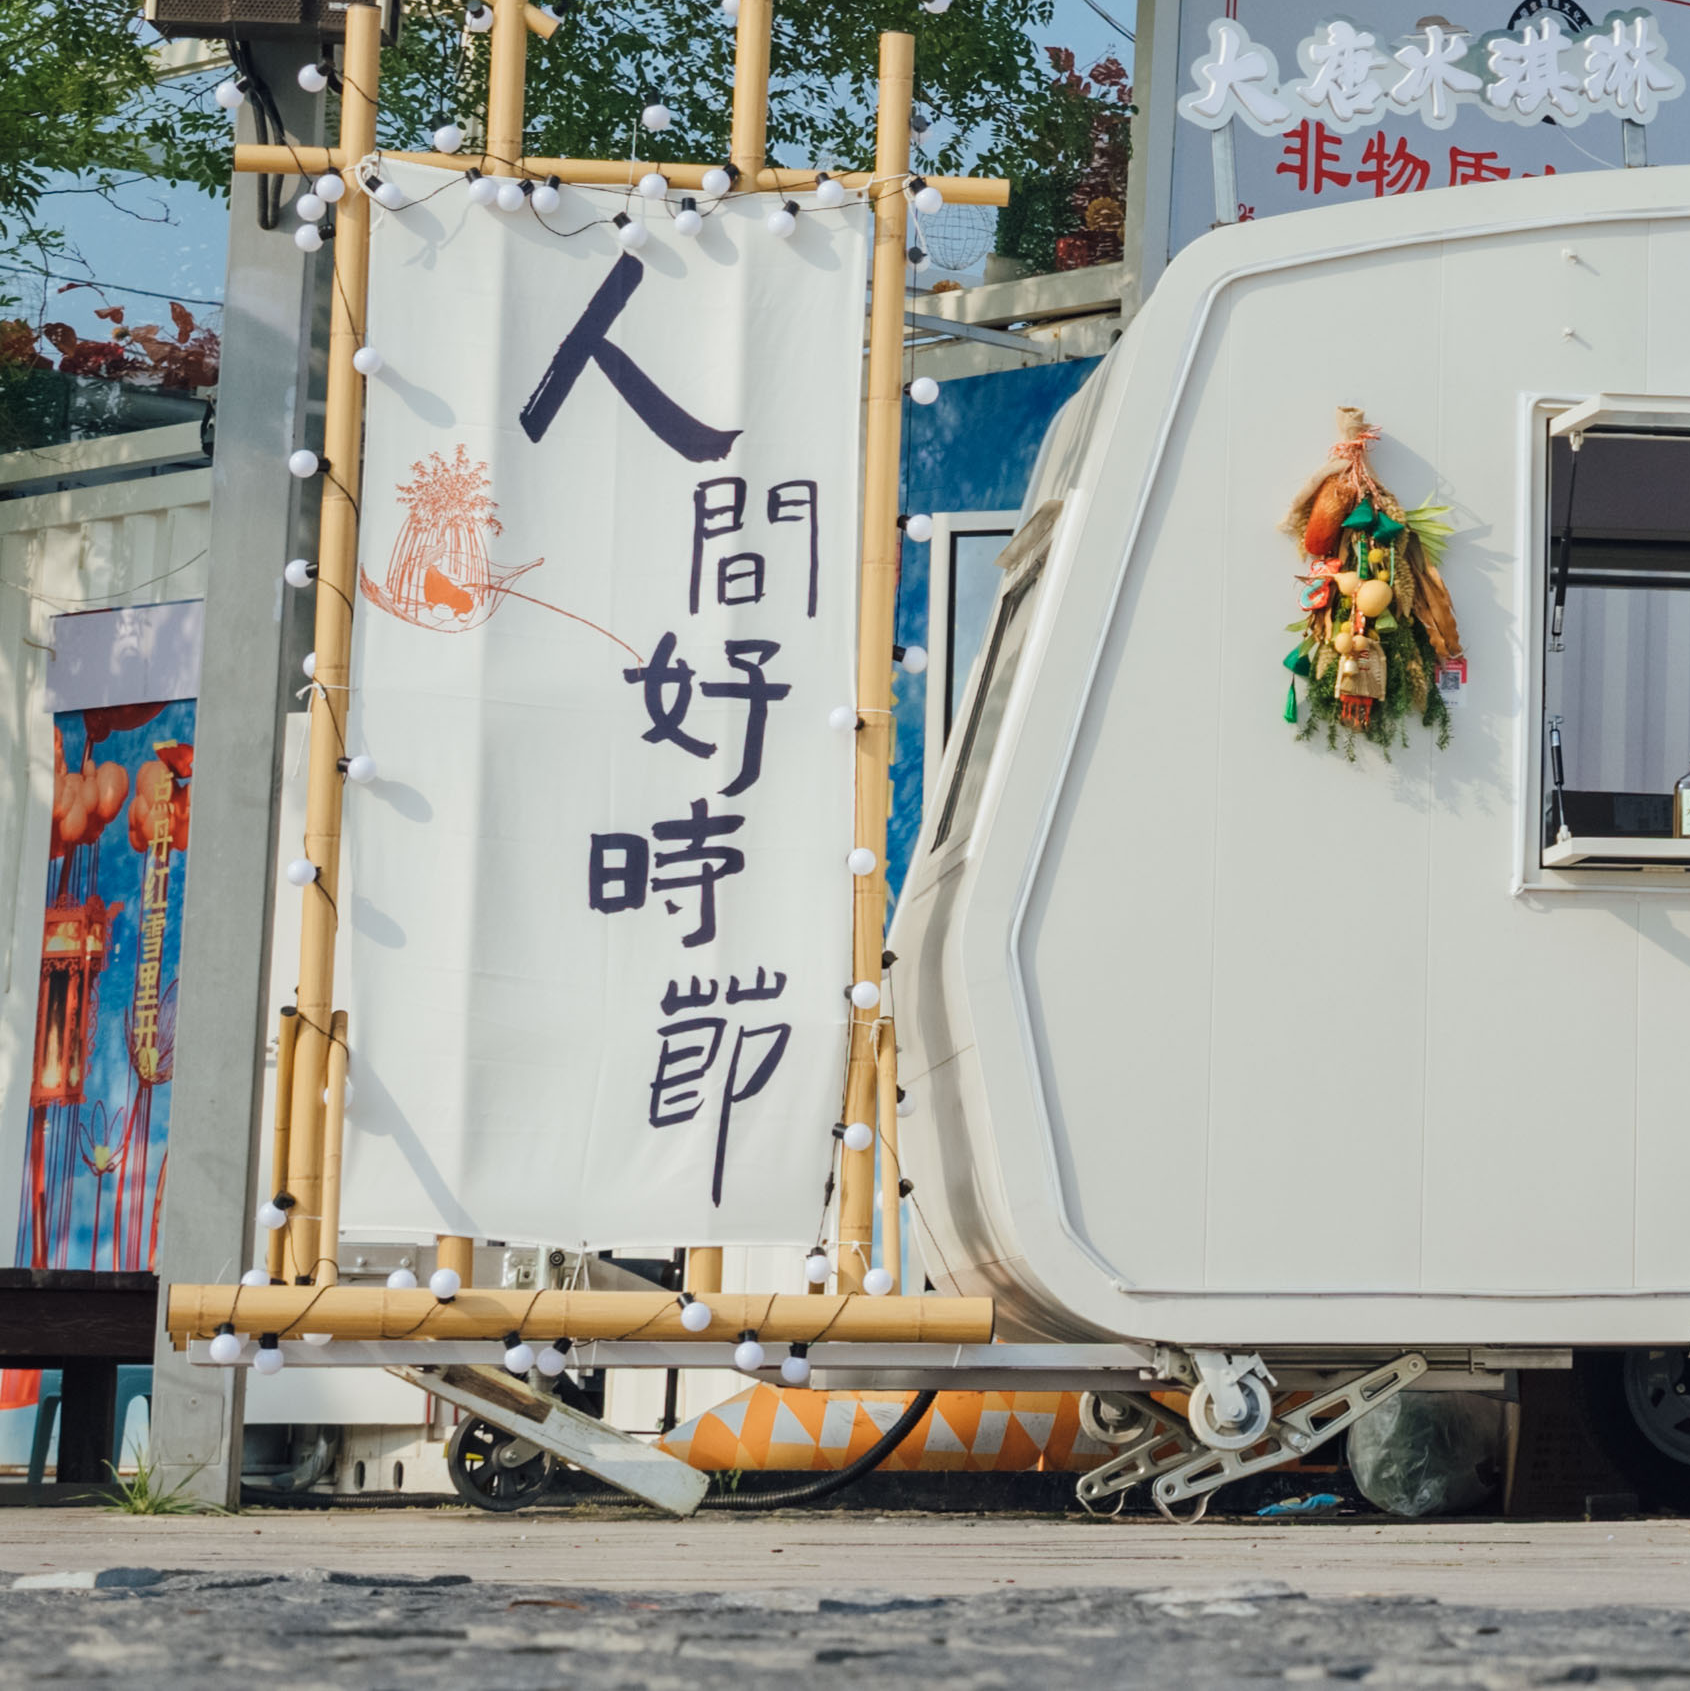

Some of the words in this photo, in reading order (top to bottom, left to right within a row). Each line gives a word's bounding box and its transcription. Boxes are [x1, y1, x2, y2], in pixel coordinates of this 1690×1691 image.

[1189, 15, 1676, 127] 大唐冰淇淋
[1276, 121, 1557, 198] 非物质
